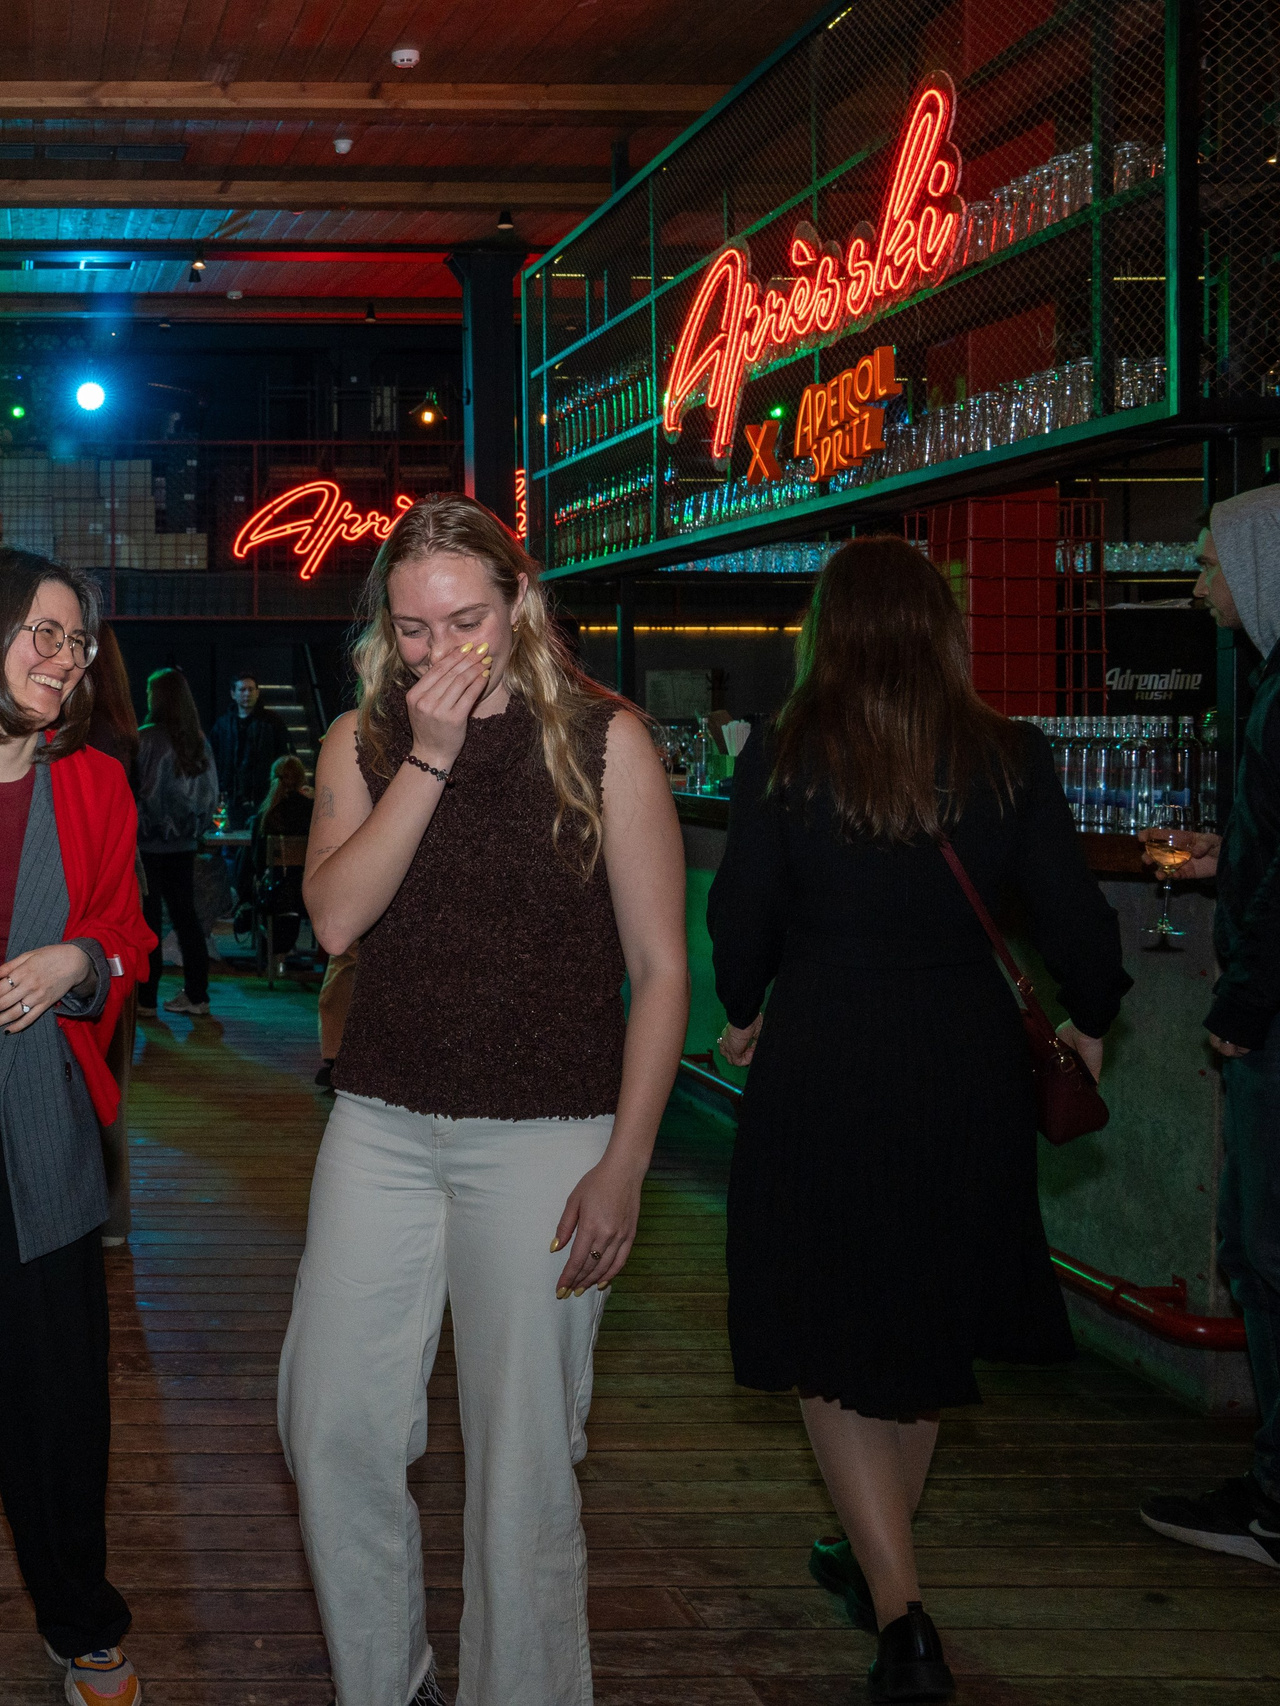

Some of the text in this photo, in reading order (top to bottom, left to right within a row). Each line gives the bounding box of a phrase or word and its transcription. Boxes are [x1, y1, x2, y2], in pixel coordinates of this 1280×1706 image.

[664, 236, 842, 458] Après
[794, 346, 902, 459] APEROL
[1105, 667, 1203, 691] Adrenaline
